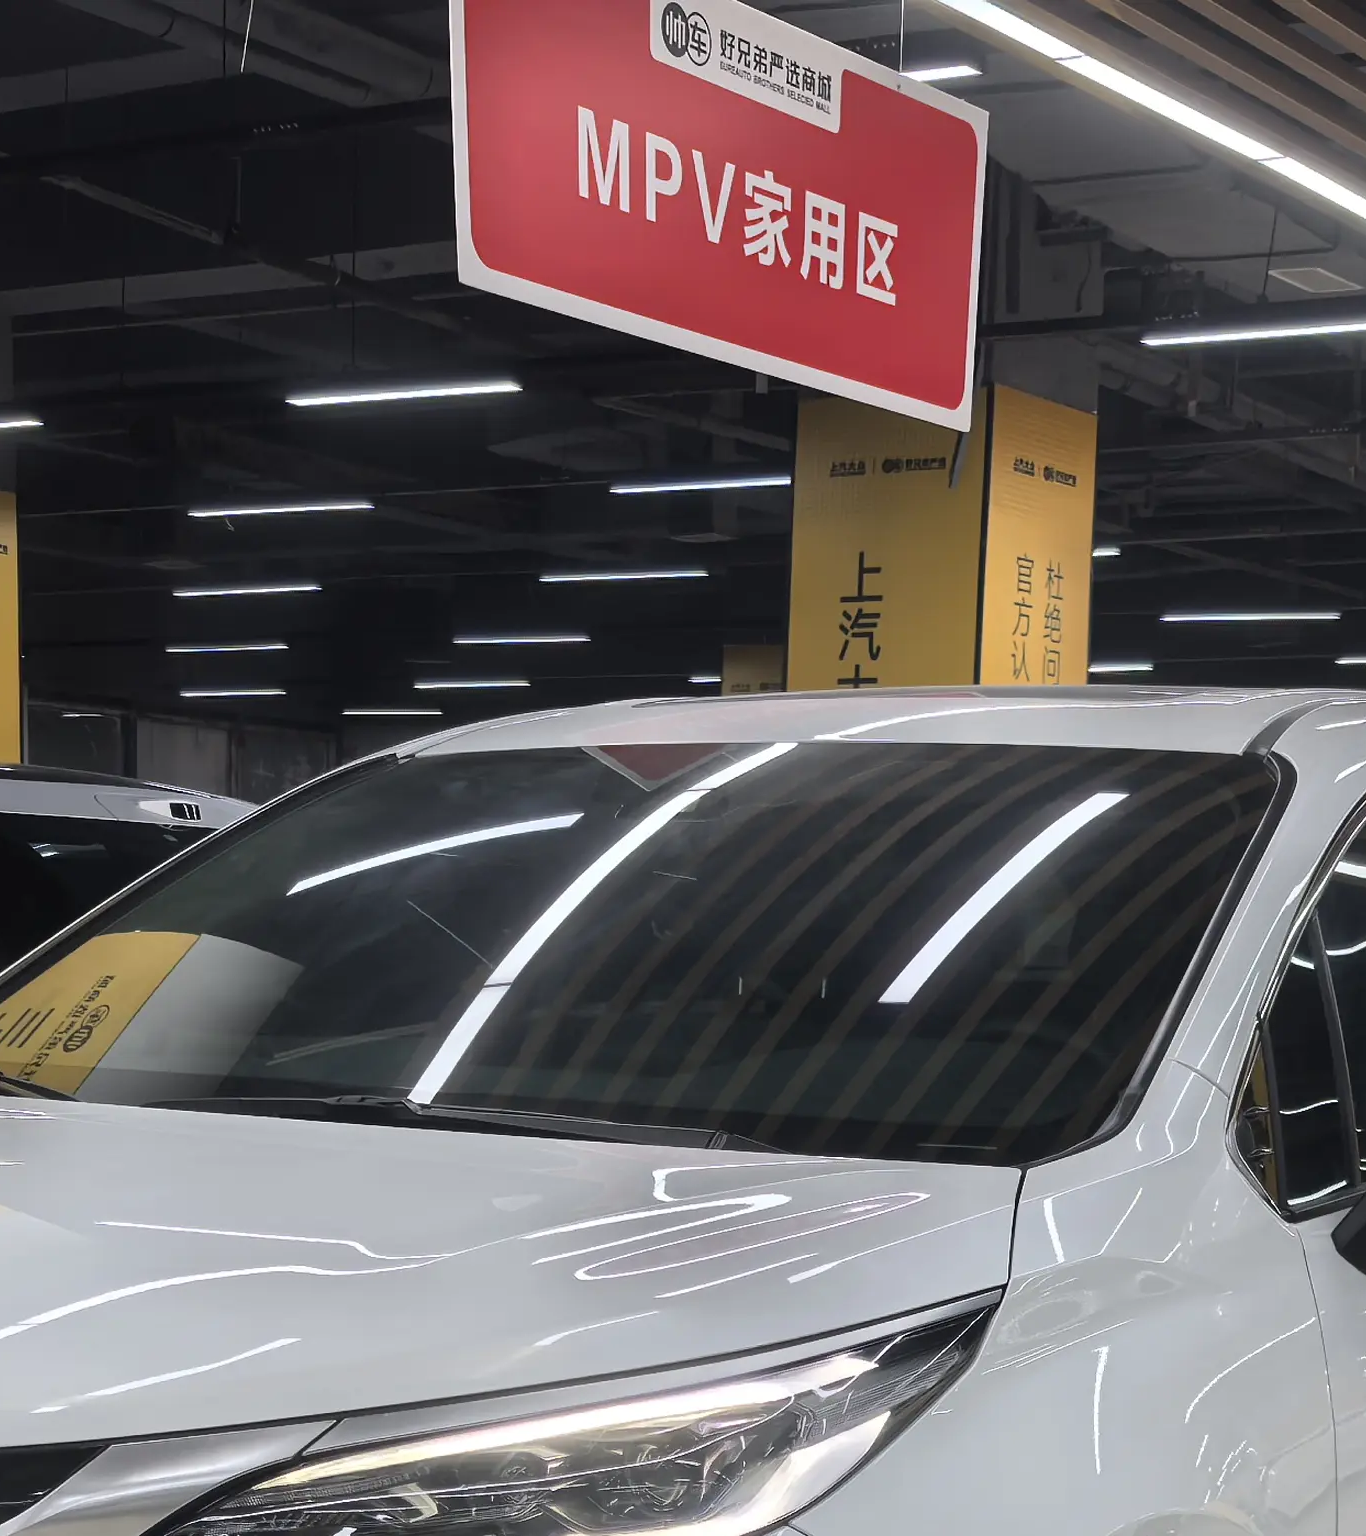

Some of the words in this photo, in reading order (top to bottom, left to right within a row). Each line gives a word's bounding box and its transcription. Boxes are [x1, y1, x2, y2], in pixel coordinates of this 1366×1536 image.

[720, 30, 832, 102] 好兄弟严选商城
[577, 105, 898, 306] MPV家用区
